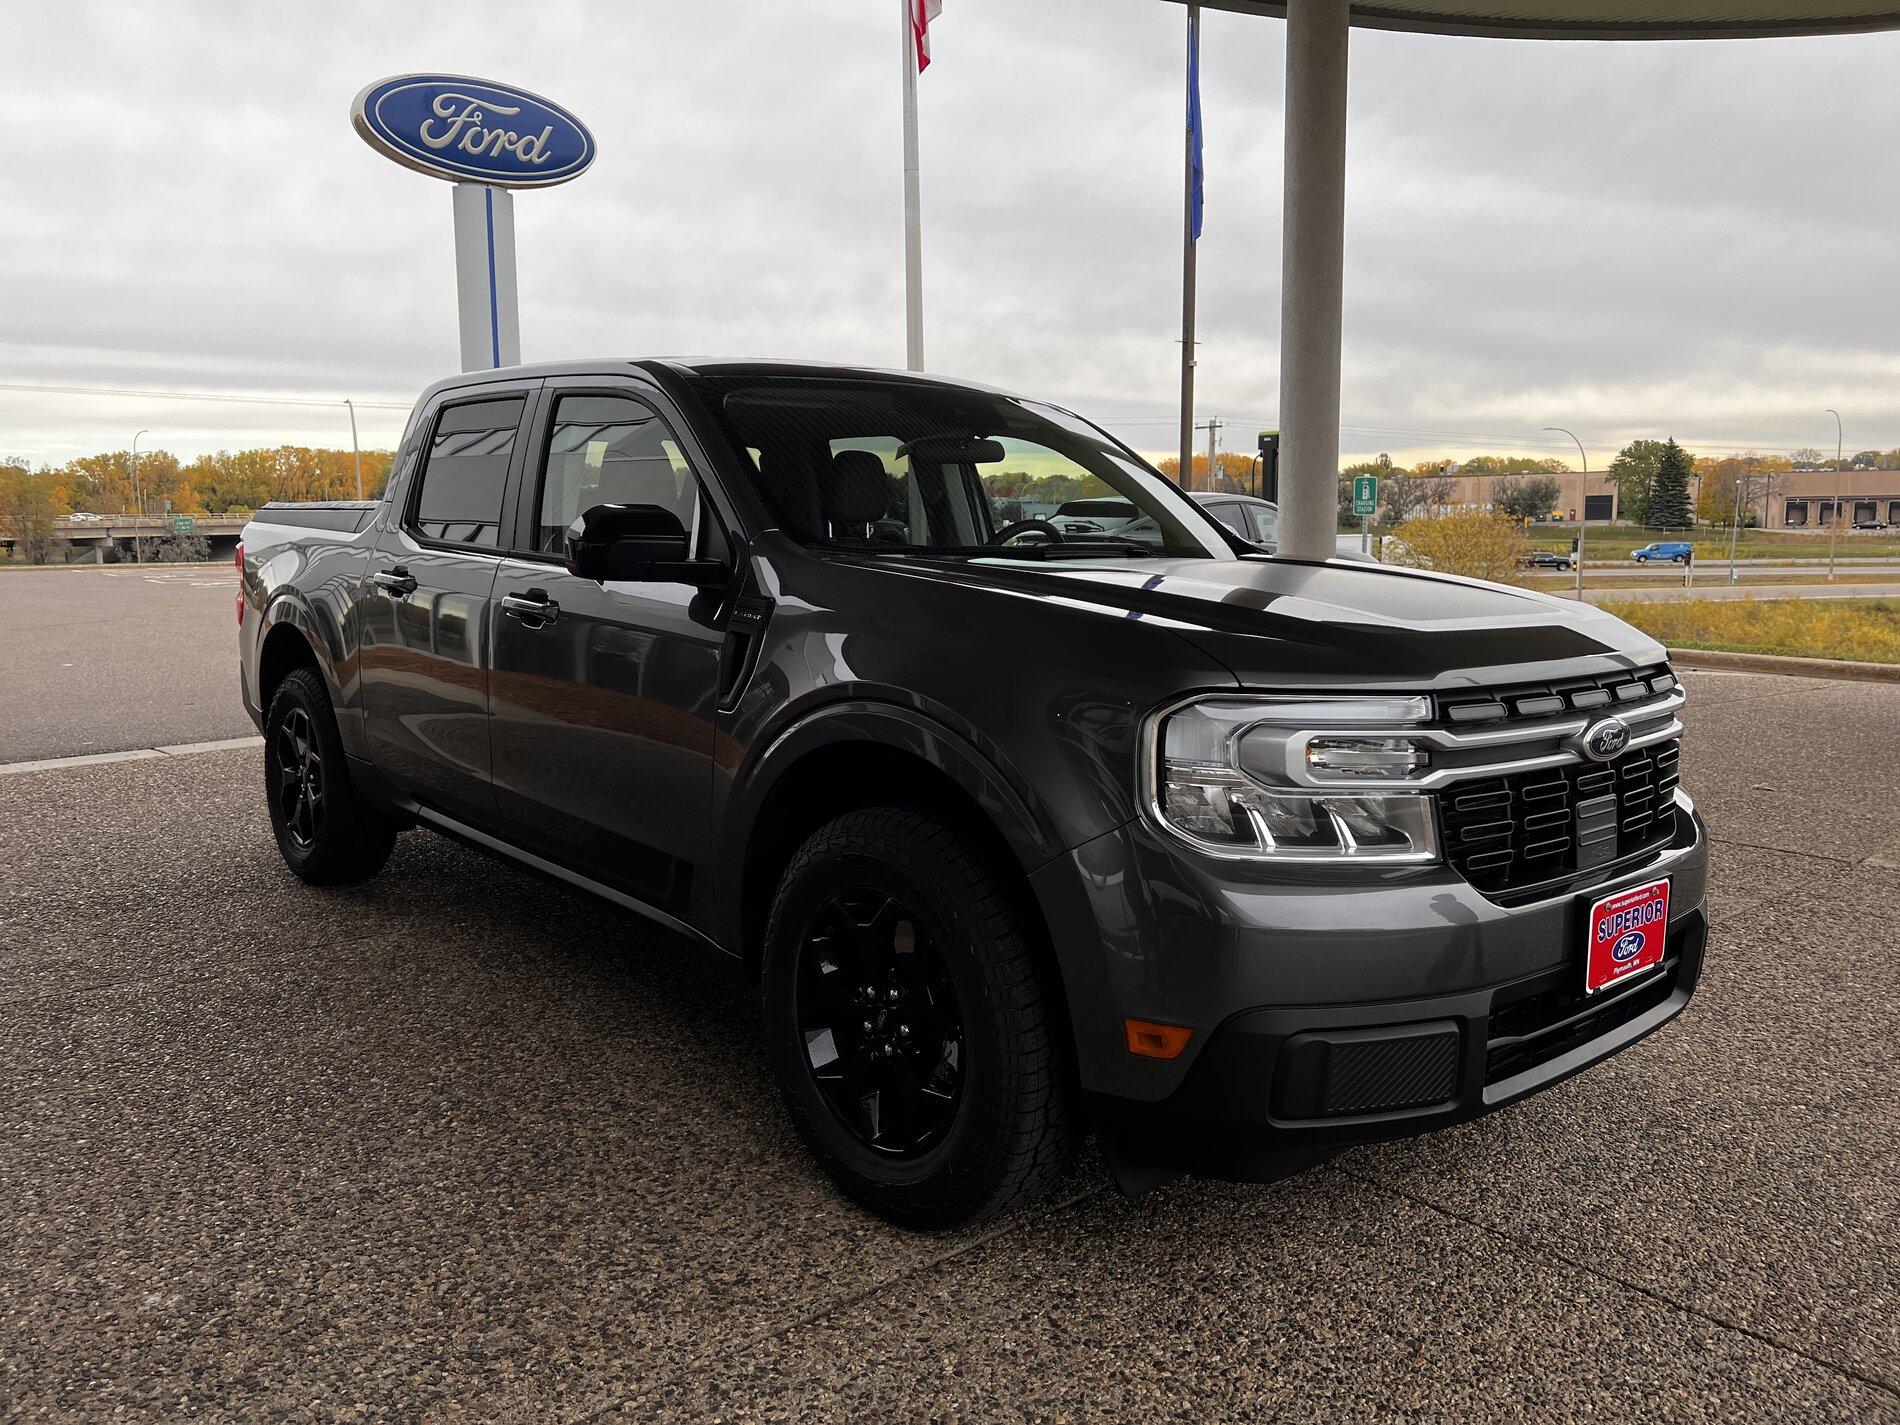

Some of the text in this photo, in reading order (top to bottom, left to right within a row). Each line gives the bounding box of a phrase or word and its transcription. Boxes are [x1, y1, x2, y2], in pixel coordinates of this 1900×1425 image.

[420, 93, 554, 164] Ford
[1600, 729, 1624, 752] Ford
[1597, 898, 1664, 942] SUPERIOR
[1617, 935, 1640, 958] Ford
